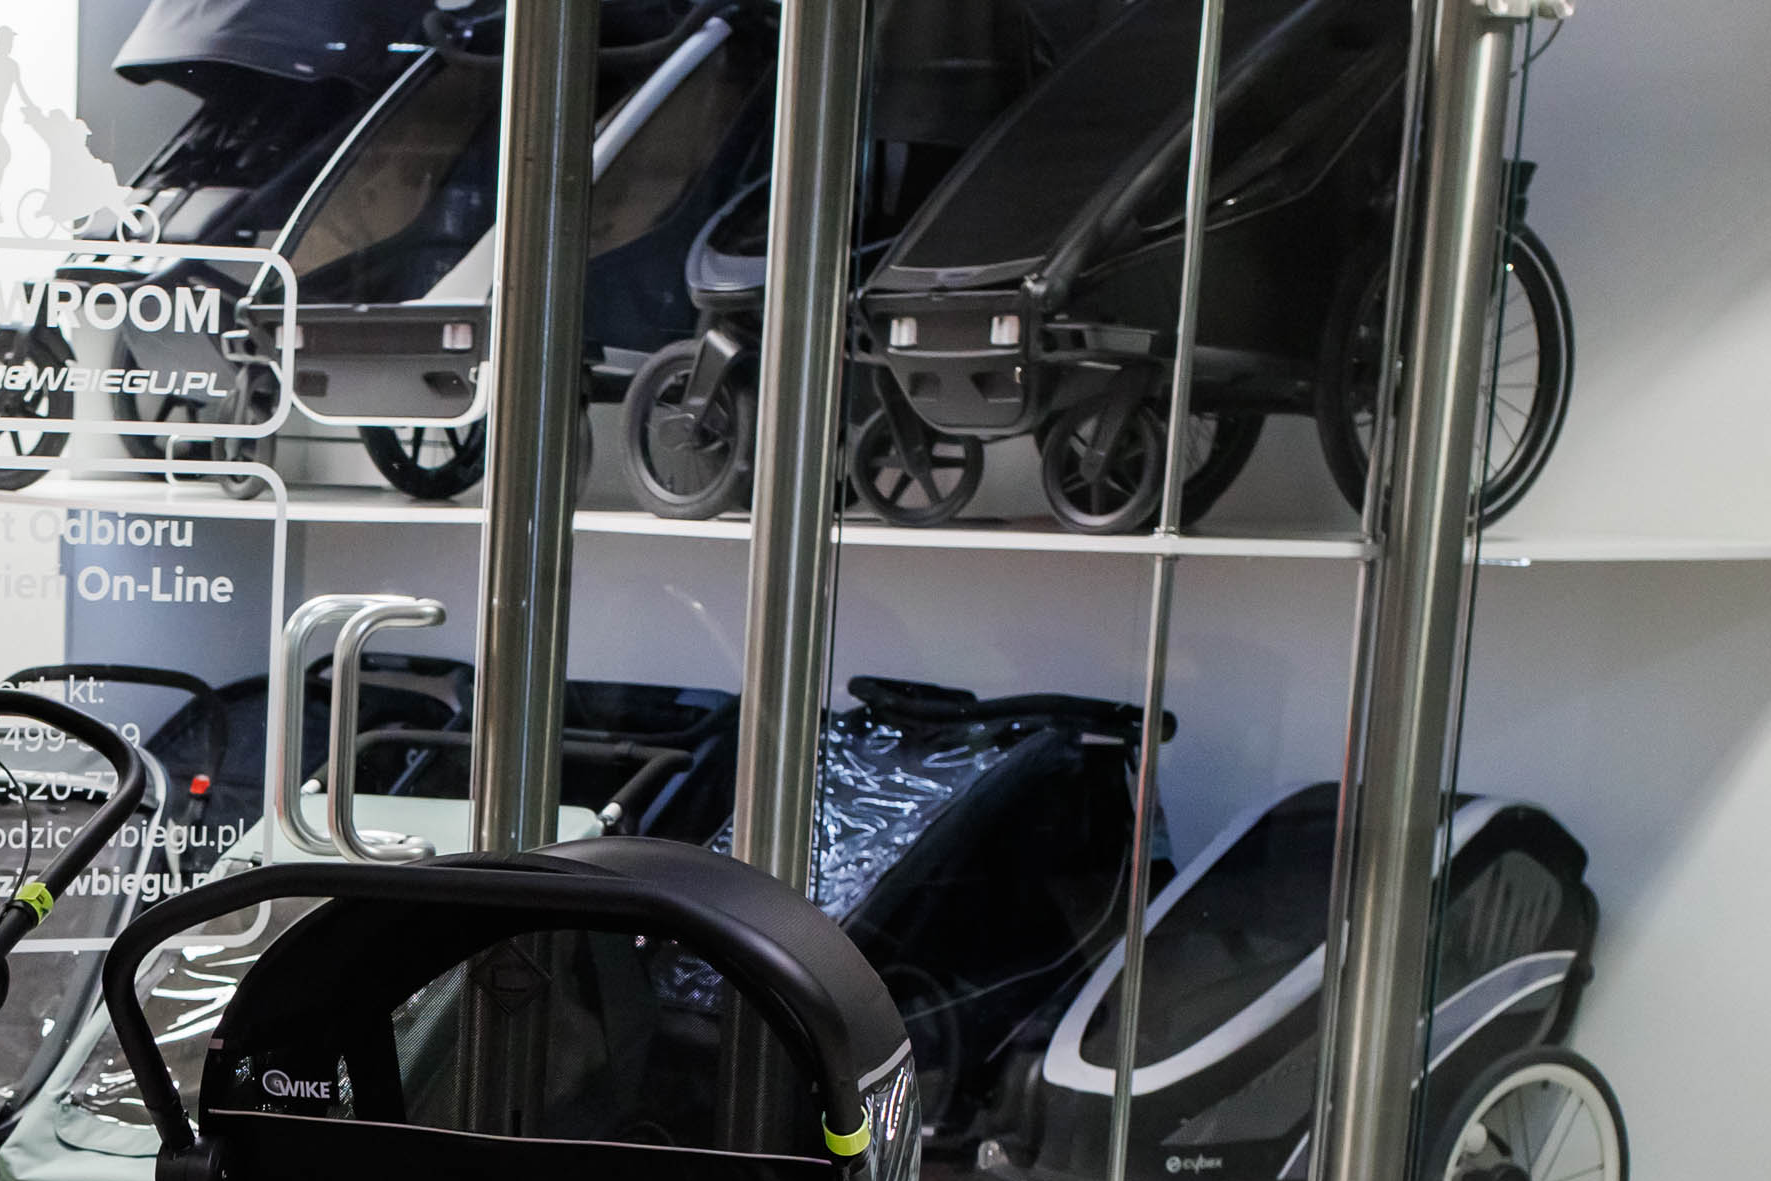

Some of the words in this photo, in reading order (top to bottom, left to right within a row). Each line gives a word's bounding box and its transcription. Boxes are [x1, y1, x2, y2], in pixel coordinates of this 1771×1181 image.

[29, 508, 194, 547] Odbioru
[76, 565, 235, 603] On-Line
[277, 1079, 333, 1099] WIKE
